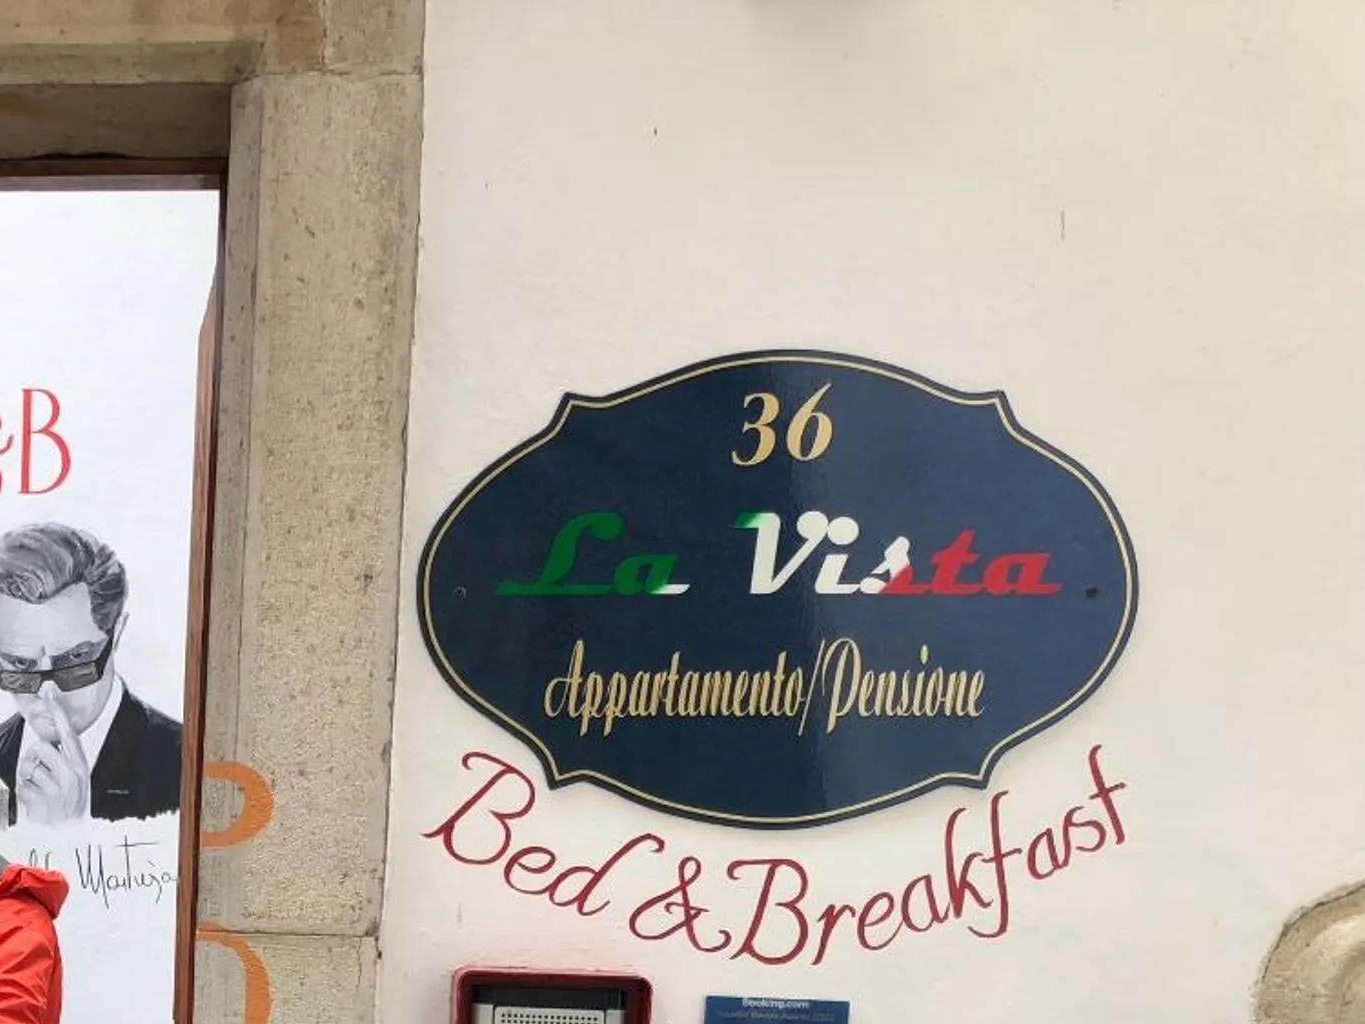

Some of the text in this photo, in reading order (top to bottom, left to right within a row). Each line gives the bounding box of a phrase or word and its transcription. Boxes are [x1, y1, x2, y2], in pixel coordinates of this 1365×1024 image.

[731, 383, 833, 466] 36
[494, 509, 1064, 596] La Vista
[421, 744, 1127, 966] Bed & Breakfast
